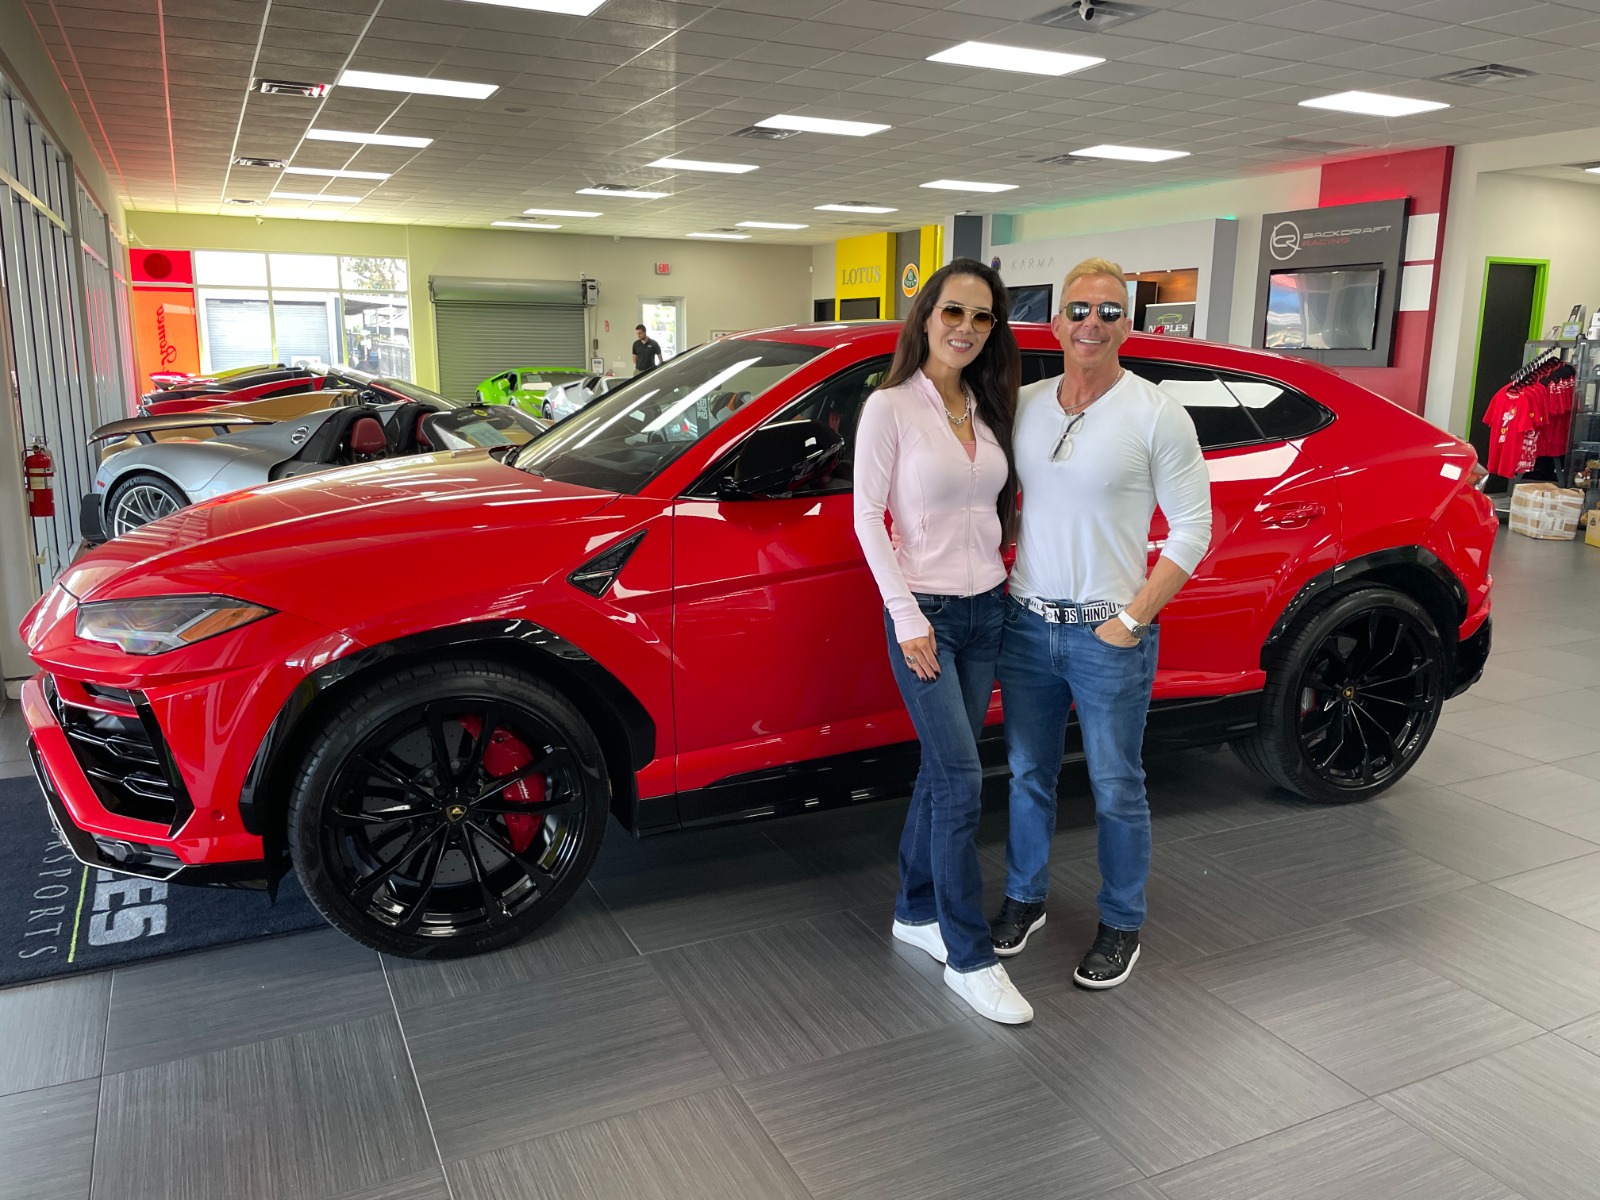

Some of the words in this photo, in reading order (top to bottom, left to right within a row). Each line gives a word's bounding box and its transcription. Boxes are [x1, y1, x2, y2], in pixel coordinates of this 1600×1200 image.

[1303, 225, 1391, 239] BACKDRAFT
[1303, 237, 1350, 247] RACING
[1011, 257, 1054, 271] KARMA
[841, 266, 880, 285] LOTUS
[1148, 323, 1188, 333] NPLES
